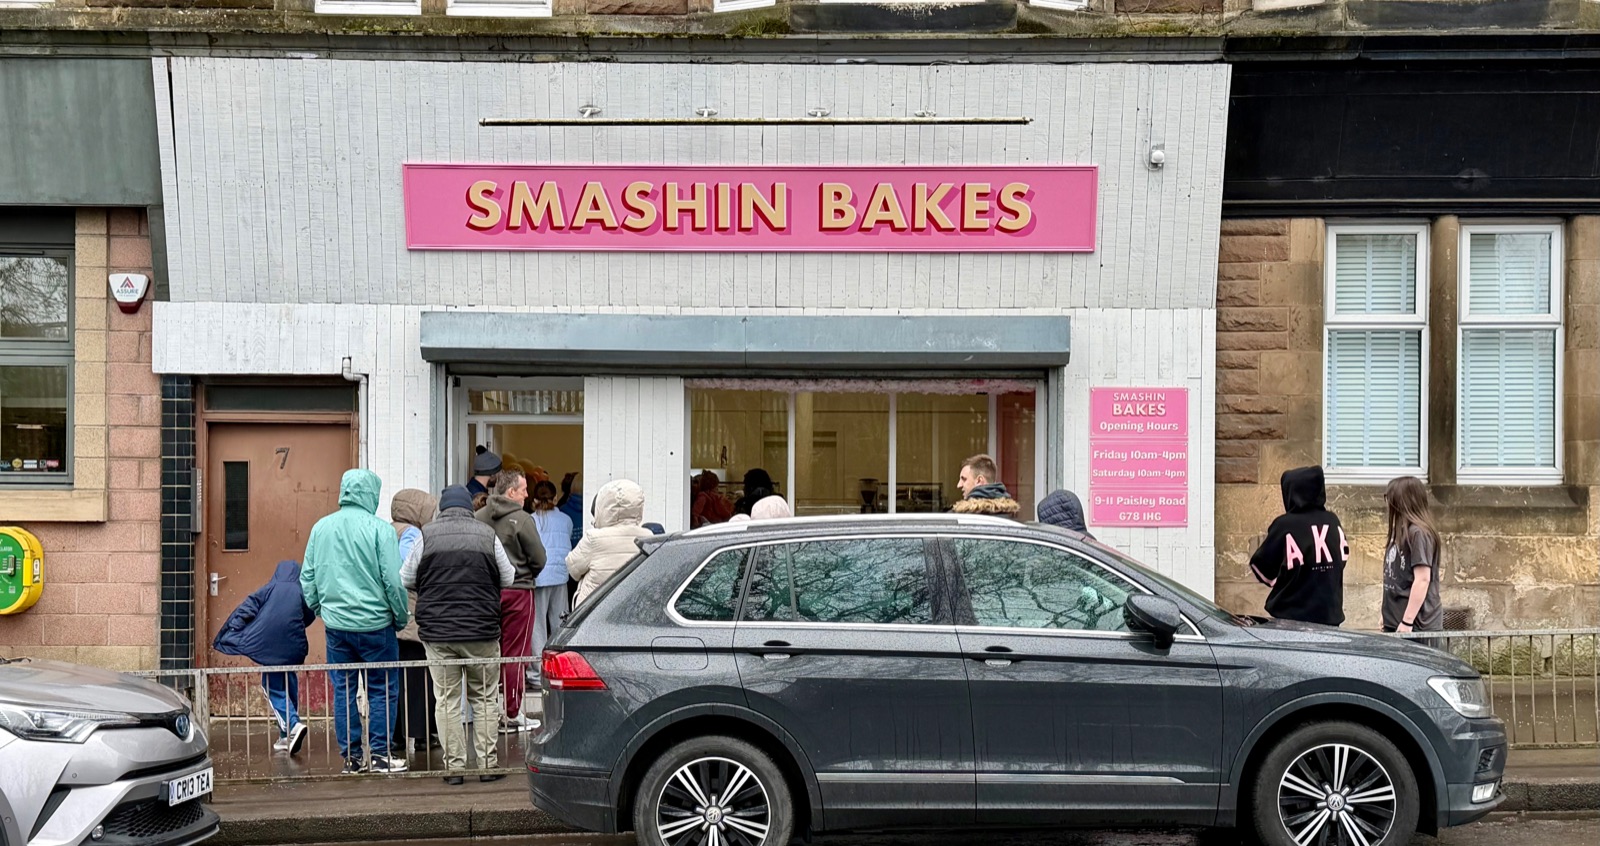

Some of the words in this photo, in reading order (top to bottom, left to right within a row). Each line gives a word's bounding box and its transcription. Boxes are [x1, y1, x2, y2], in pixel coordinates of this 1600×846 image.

[465, 180, 788, 231] SMASHIN
[819, 182, 1033, 232] BAKES
[1113, 392, 1165, 401] SMASHIN
[1113, 403, 1166, 416] BAKES
[1100, 420, 1144, 433] Opening
[1146, 421, 1179, 431] Hours
[275, 447, 291, 469] 7
[1093, 450, 1128, 462] Friday
[1130, 450, 1186, 461] 10am-4pm
[1092, 469, 1135, 479] Saturday
[1137, 469, 1185, 479] 10am-4pm
[1094, 496, 1114, 506] 9-11
[1116, 495, 1156, 508] Paisley
[1158, 496, 1186, 506] Road
[1119, 511, 1140, 521] G78
[1142, 512, 1162, 521] 1HG
[176, 777, 195, 800] CR13
[196, 772, 211, 793] TEA
